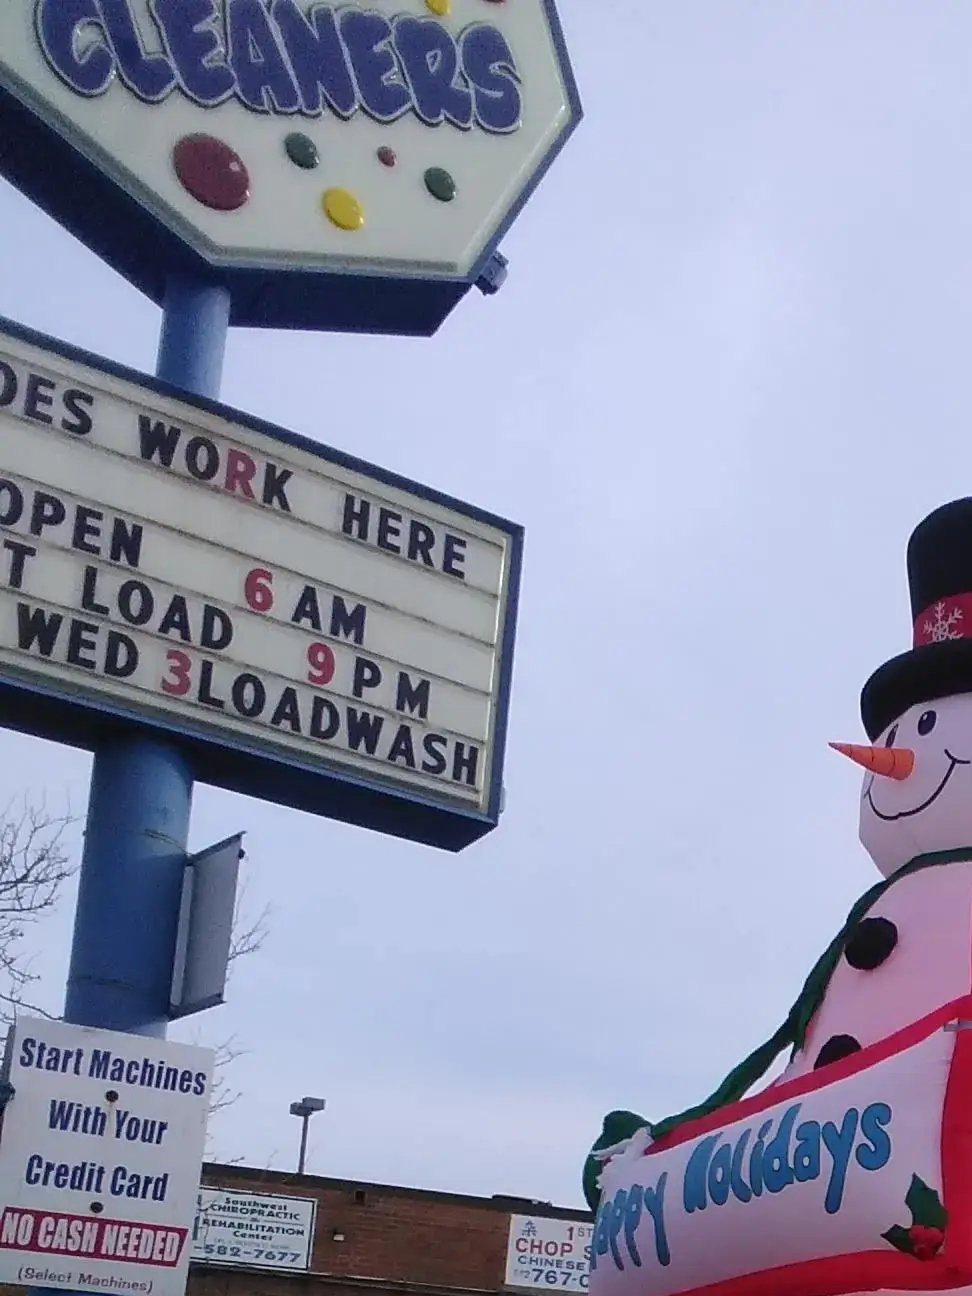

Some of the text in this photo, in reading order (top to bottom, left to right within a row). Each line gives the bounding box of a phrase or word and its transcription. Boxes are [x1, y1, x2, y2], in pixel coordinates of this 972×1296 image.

[35, 0, 522, 134] CLEANERS
[138, 414, 293, 512] WORK
[342, 493, 467, 579] HERE
[0, 478, 366, 645] OPEN 6 AM
[16, 602, 138, 677] WED
[82, 565, 233, 650] LOAD
[306, 643, 335, 685] 9
[19, 1037, 207, 1096] Start Machines
[48, 1099, 168, 1145] With Your
[25, 1154, 169, 1201] Credit Card
[683, 1102, 892, 1214] Holidays
[1, 1210, 181, 1262] NO CASH NEEDED
[202, 1218, 304, 1236] REHABILITATION
[209, 1203, 301, 1220] CHIROPRACTIC
[515, 1238, 573, 1257] CHOP
[517, 1255, 586, 1271] CHINESE
[17, 1266, 154, 1294] (Select Machines)
